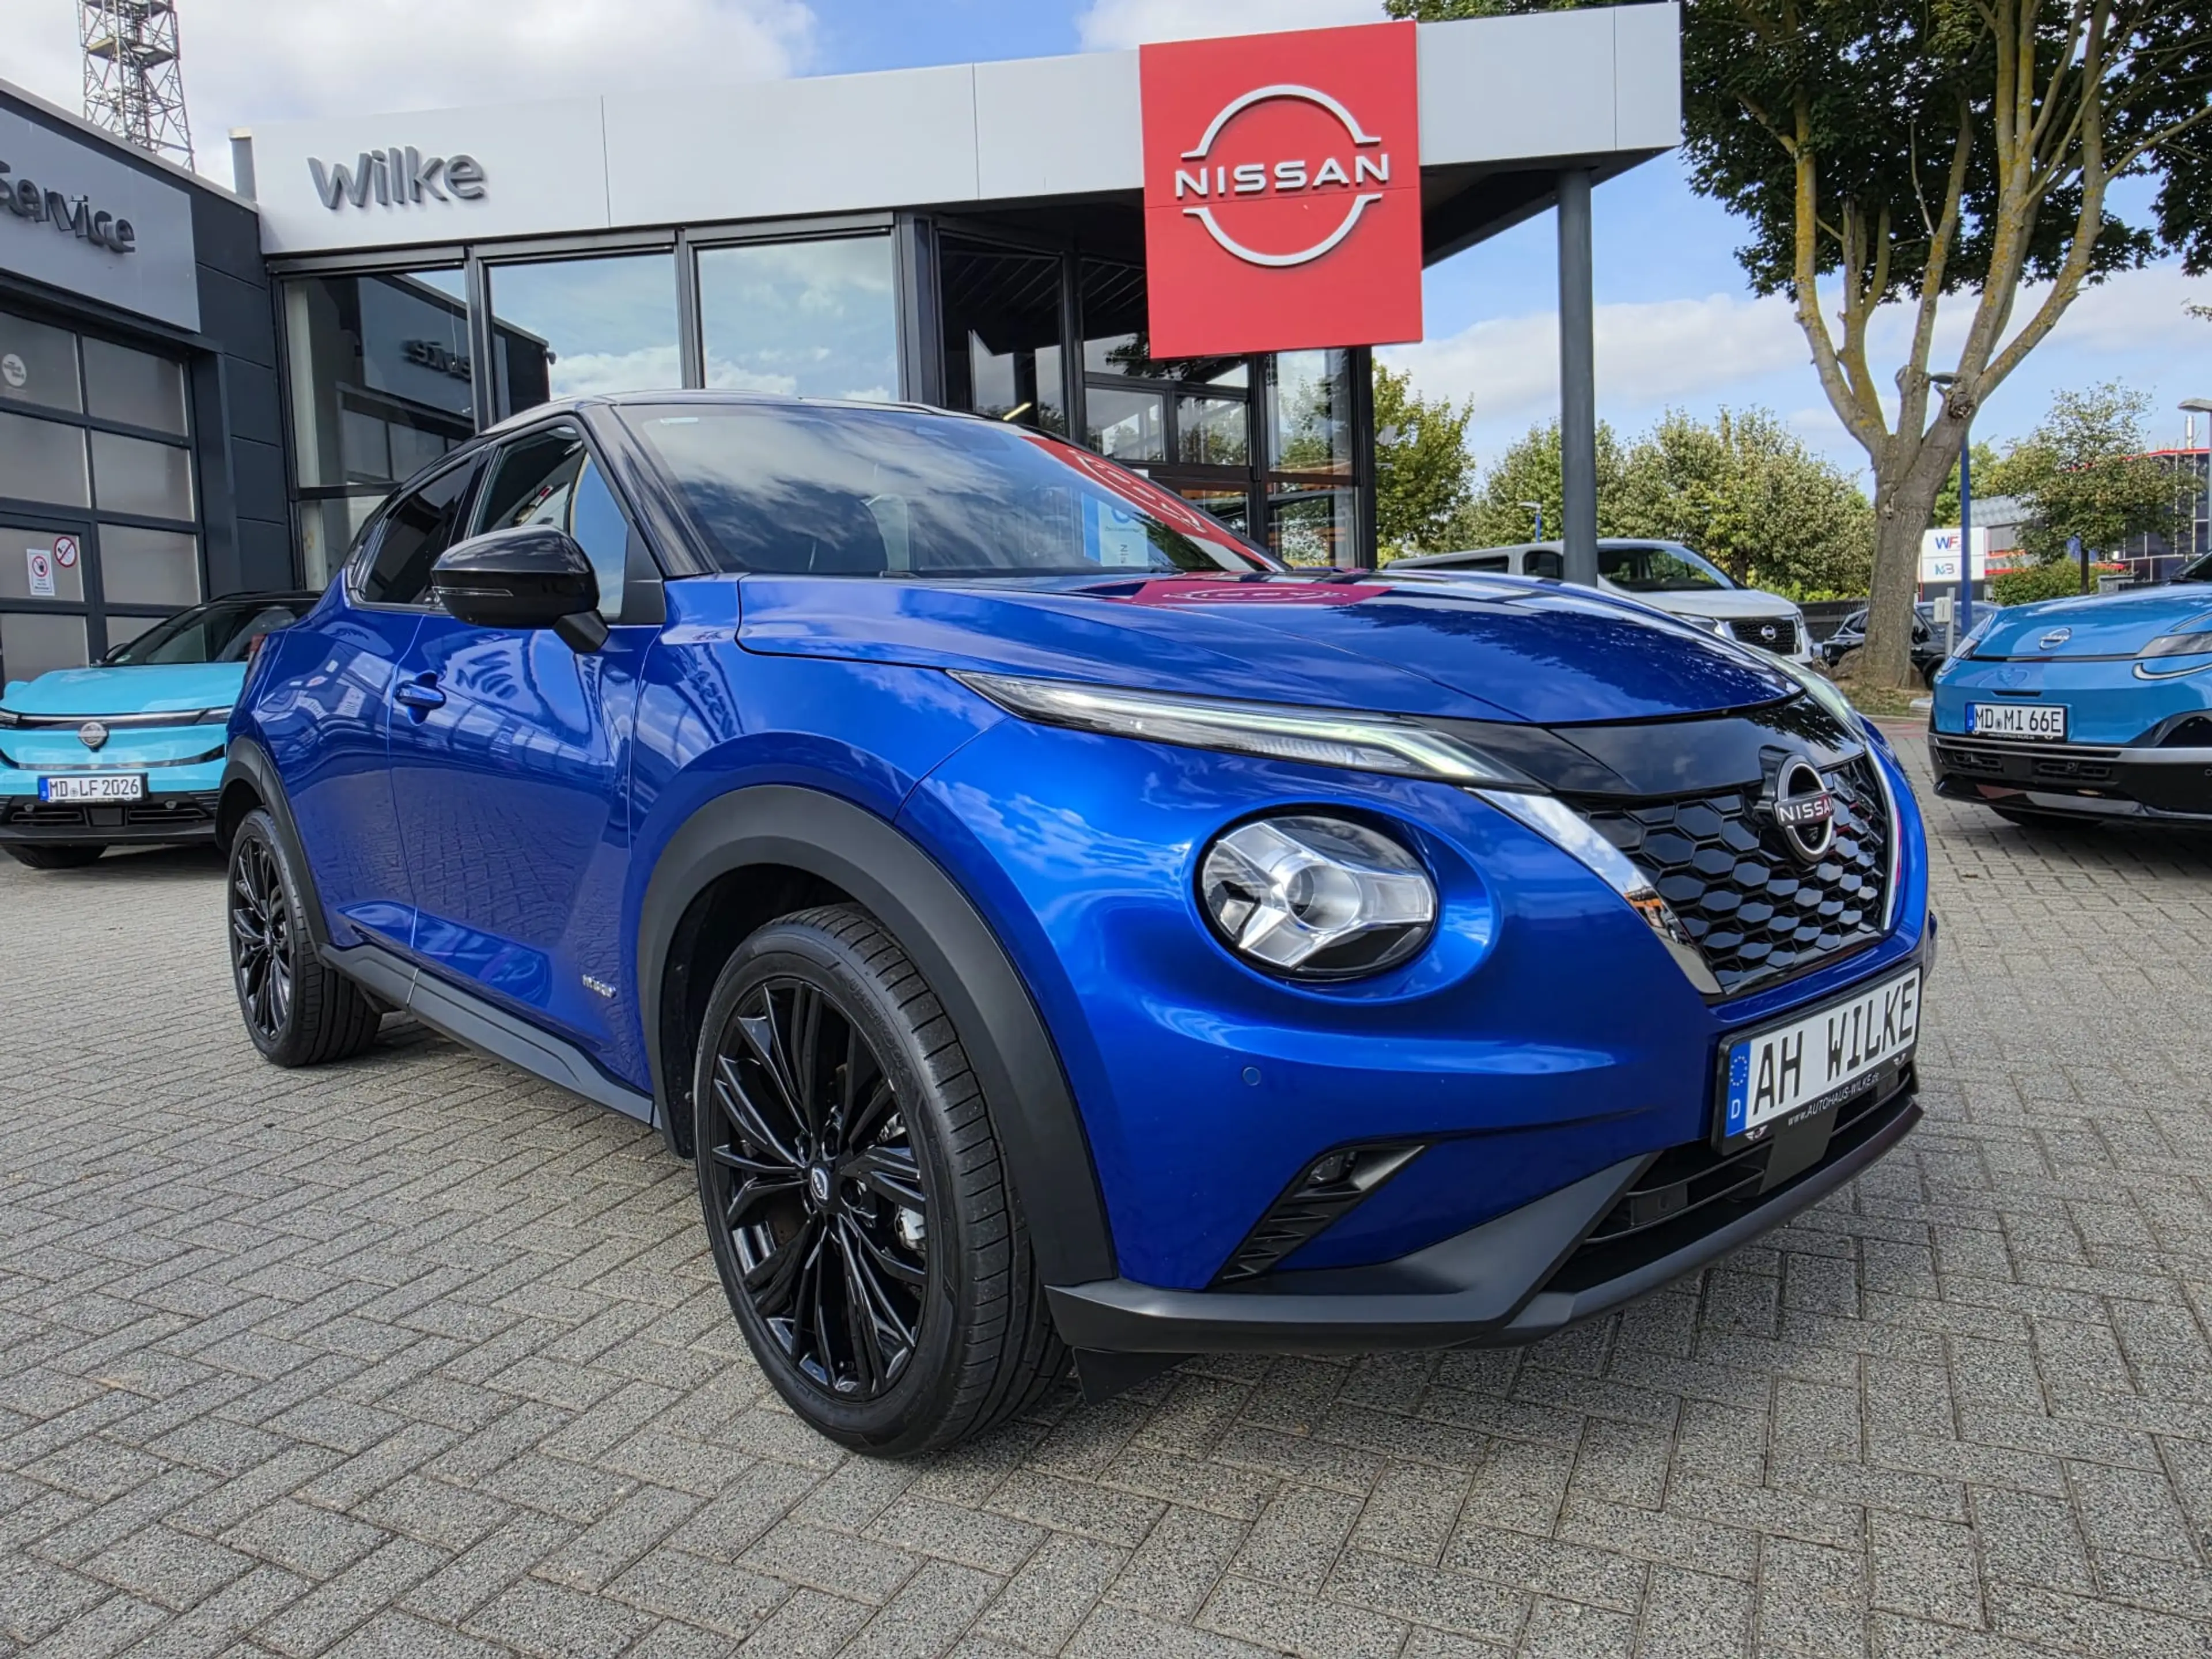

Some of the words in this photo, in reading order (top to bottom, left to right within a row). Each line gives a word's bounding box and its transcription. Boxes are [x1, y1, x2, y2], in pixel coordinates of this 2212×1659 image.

[307, 146, 486, 210] Wilke
[1175, 154, 1389, 199] NISSAN
[1975, 708, 1994, 729] MD
[2004, 709, 2024, 730] MI
[2029, 710, 2062, 732] 66E
[50, 781, 67, 797] MD
[79, 779, 98, 796] LF
[102, 778, 139, 796] 2026
[1730, 1099, 1740, 1119] D
[1753, 1031, 1803, 1116] AH
[1827, 978, 1915, 1081] WILKE
